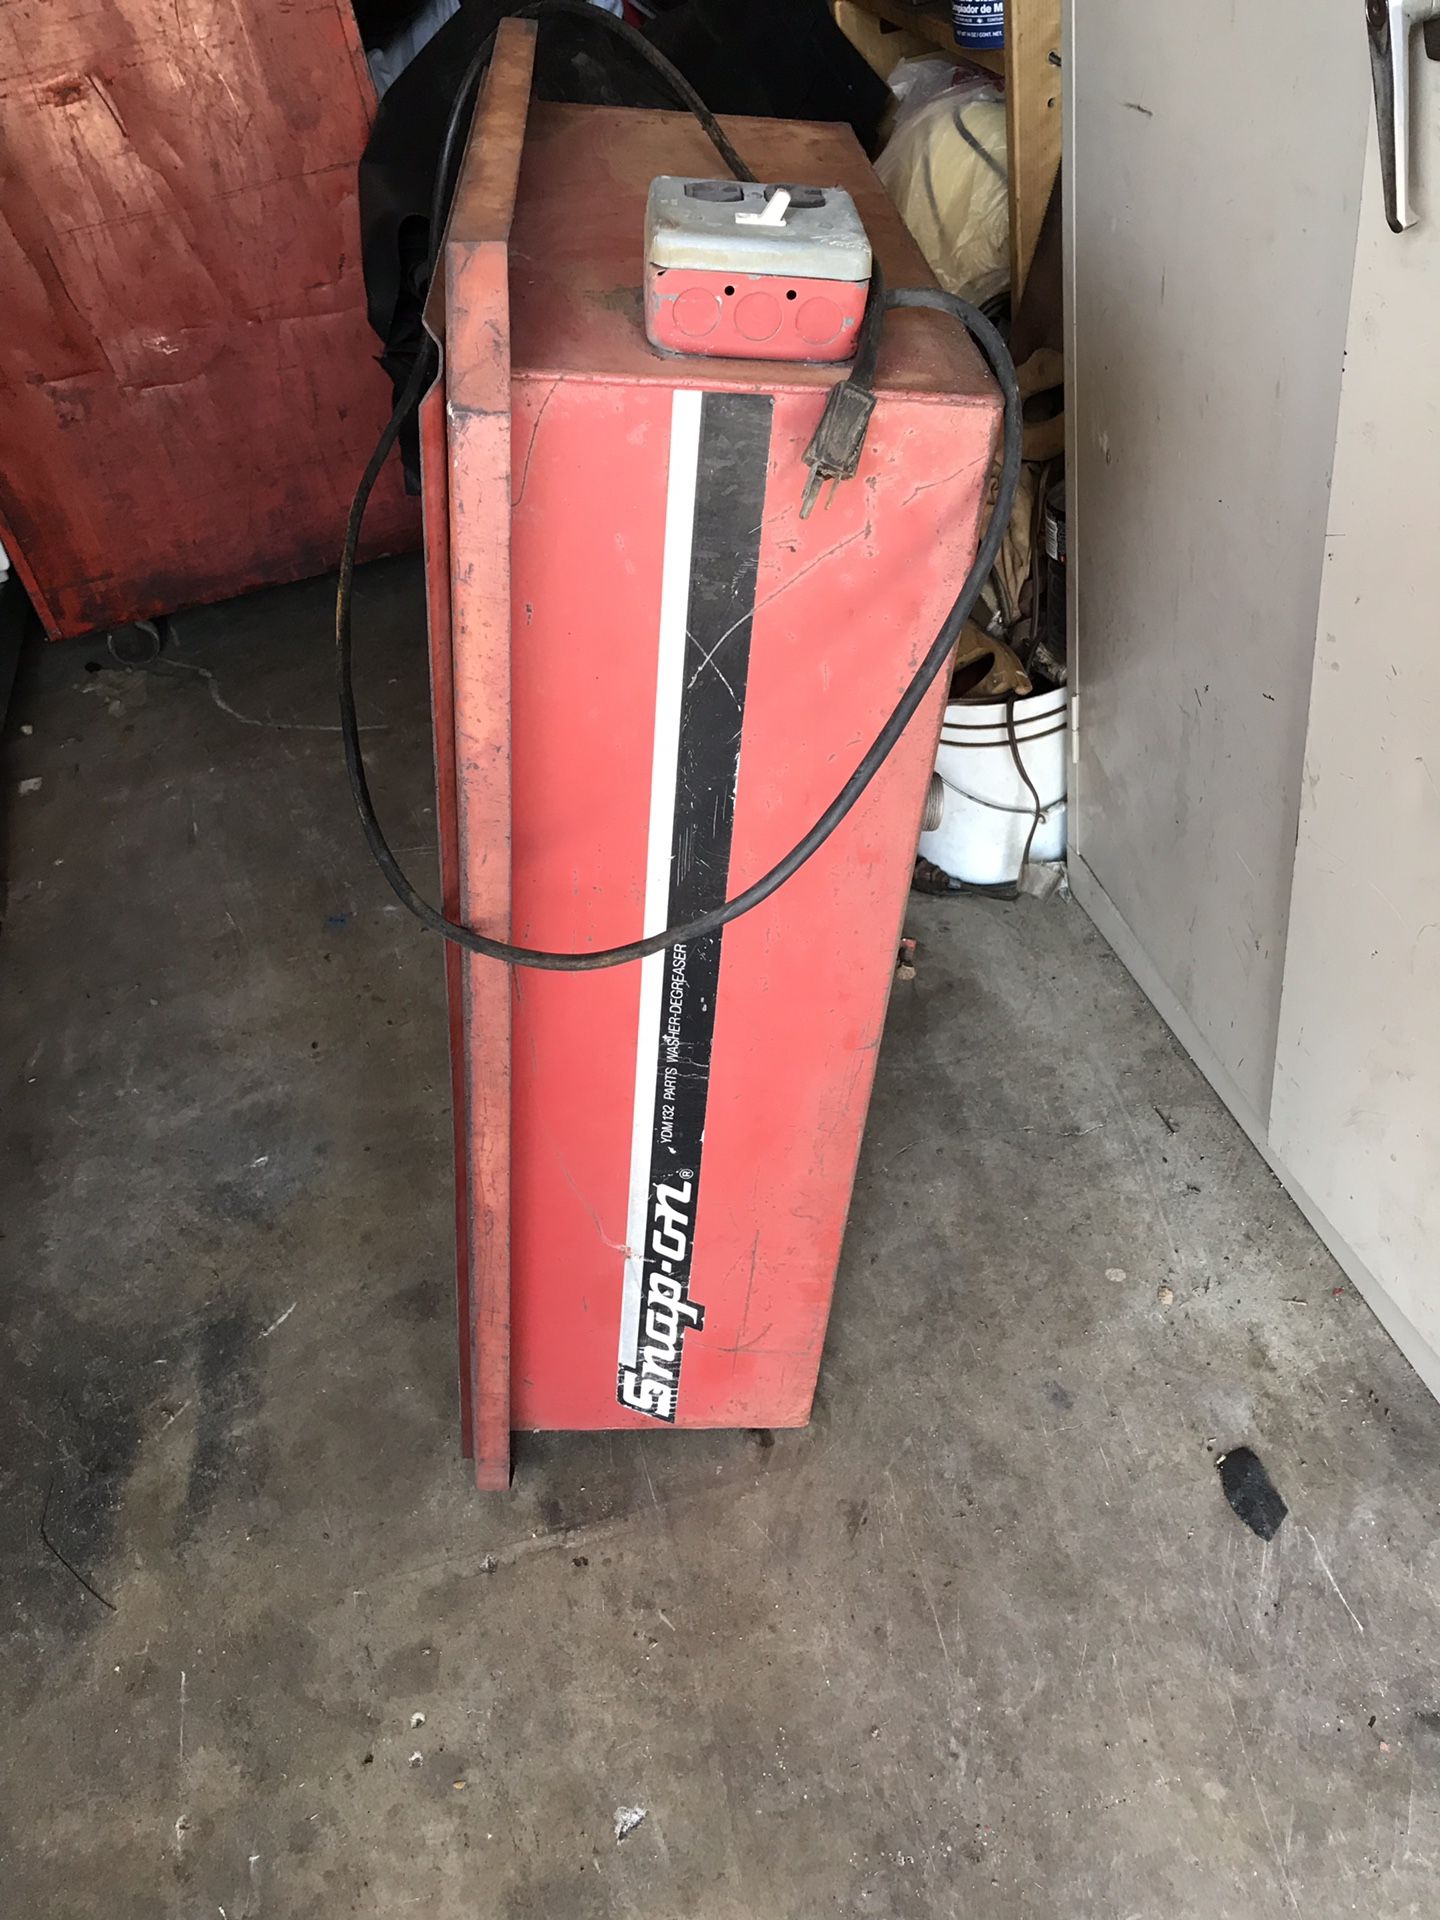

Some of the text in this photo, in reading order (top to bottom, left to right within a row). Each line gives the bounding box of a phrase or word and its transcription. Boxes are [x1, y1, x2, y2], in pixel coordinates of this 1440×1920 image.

[980, 4, 992, 14] de
[660, 943, 687, 1144] YDM132 PARTS WASHER-DEGREASER
